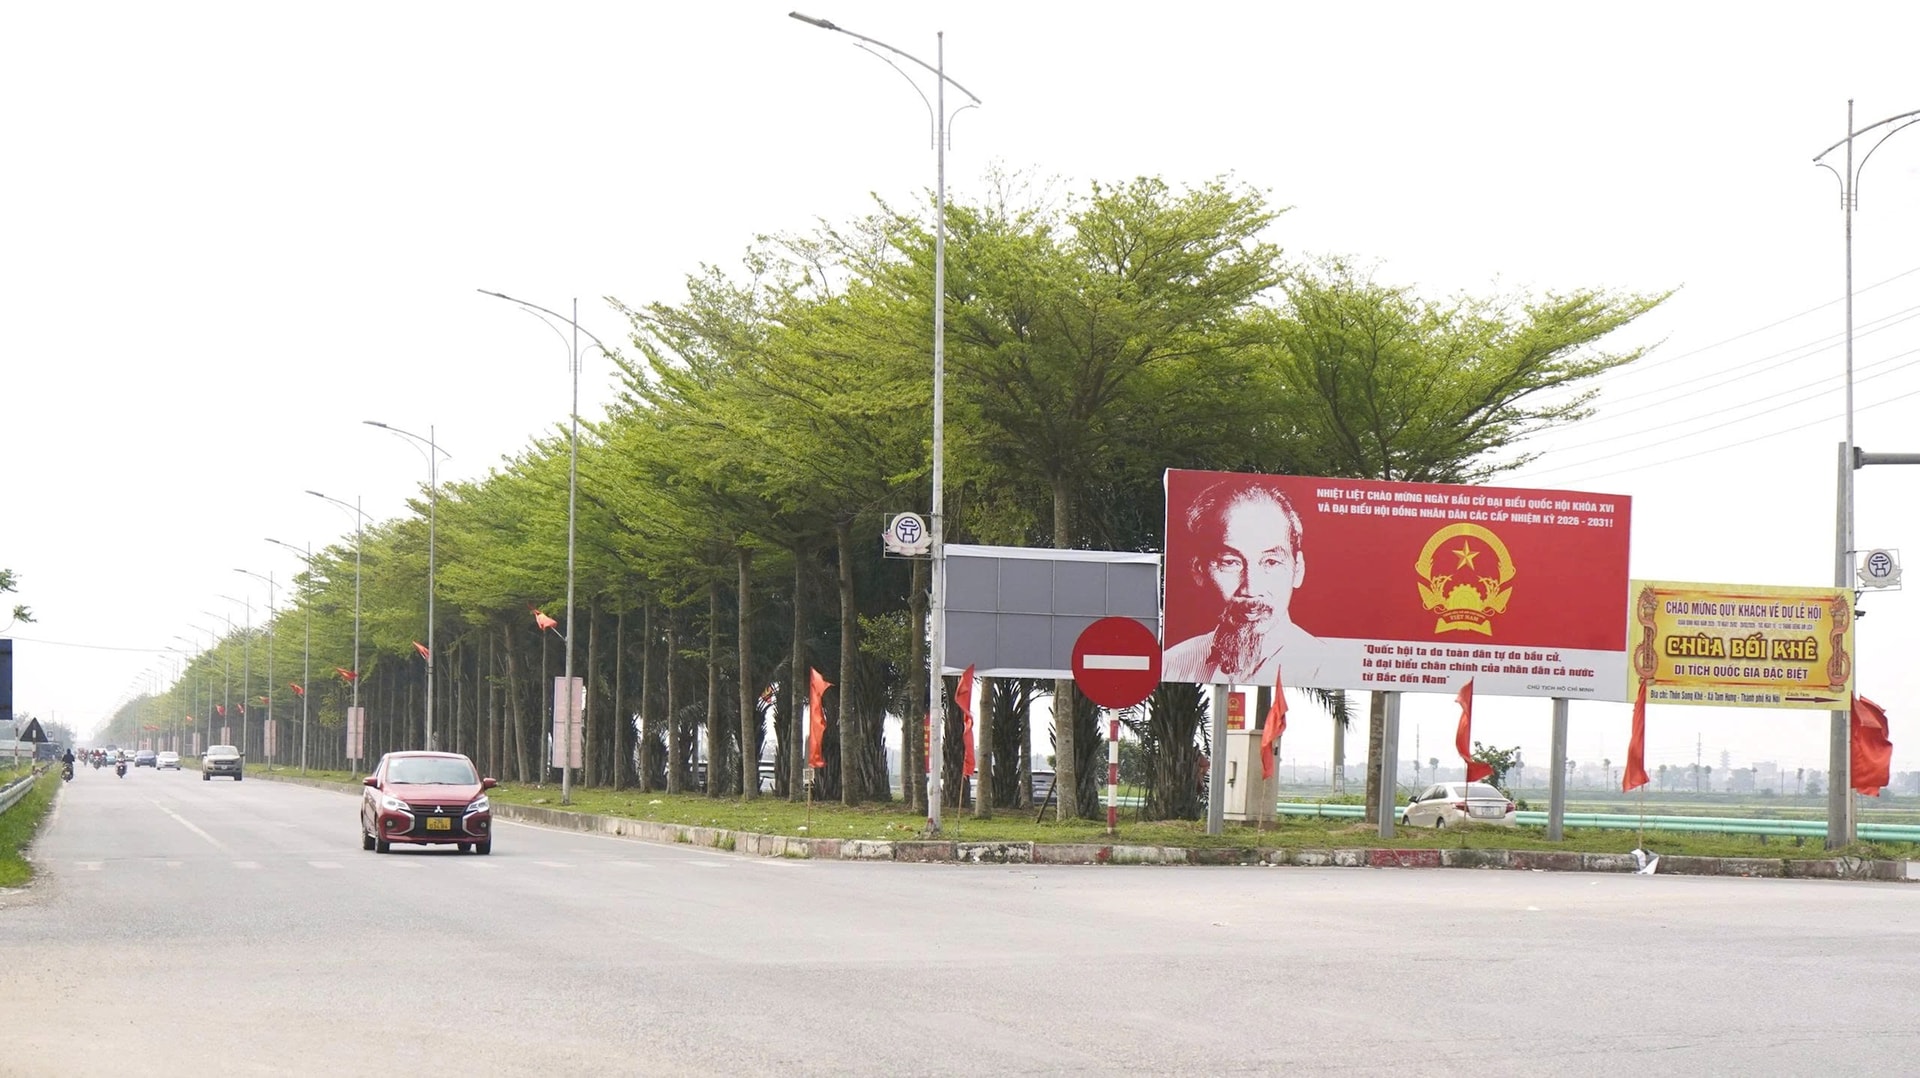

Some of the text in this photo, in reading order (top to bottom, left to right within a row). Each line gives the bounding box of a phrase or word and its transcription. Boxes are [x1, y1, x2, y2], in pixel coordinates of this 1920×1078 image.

[1317, 488, 1343, 500] NHIỆT
[1346, 490, 1365, 501] LIỆT
[1367, 490, 1391, 501] CHÀO
[1395, 492, 1422, 502] MỪNG
[1424, 492, 1449, 504] NGÀY
[1473, 494, 1486, 506] CỬ
[1487, 498, 1502, 508] ĐẠI
[1505, 496, 1525, 507] BIỂU
[1528, 497, 1552, 509] QUỐC
[1555, 500, 1570, 510] HỘI
[1573, 501, 1597, 512] KHÓA
[1600, 504, 1614, 512] XVI
[1318, 502, 1330, 512] VÀ
[1333, 504, 1348, 515] ĐẠI
[1350, 503, 1371, 514] BIỂU
[1374, 505, 1389, 517] HỘI
[1420, 507, 1446, 518] NHÂN
[1448, 508, 1467, 519] DÂN
[1470, 510, 1489, 520] CÁC
[1491, 511, 1508, 521] CẤP
[1511, 512, 1541, 524] NHIỆM
[1543, 514, 1555, 524] KỲ
[1557, 516, 1579, 525] 2026
[1588, 518, 1613, 527] 2031!
[1666, 601, 1689, 614] CHÀO
[1692, 601, 1716, 616] MỪNG
[1739, 604, 1766, 617] KHÁCH
[1782, 606, 1794, 620] DỰ
[1808, 606, 1821, 622] HỘI
[1397, 646, 1413, 657] hội
[1430, 648, 1442, 656] do
[1446, 649, 1469, 657] toàn
[1472, 649, 1491, 658] dân
[1495, 651, 1506, 661] tự
[1667, 633, 1725, 657] CHÙA
[1731, 633, 1767, 658] BỐI
[1772, 637, 1817, 660] KHÊ
[1363, 658, 1594, 677] là đại biểu chân chính của nhân dân cả nước
[1363, 672, 1374, 681] từ
[1376, 672, 1396, 682] Bắc
[1400, 673, 1418, 682] đến
[1675, 665, 1808, 681] DI TÍCH QUỐC GIA ĐẶC BIỆT
[1682, 691, 1693, 701] Song
